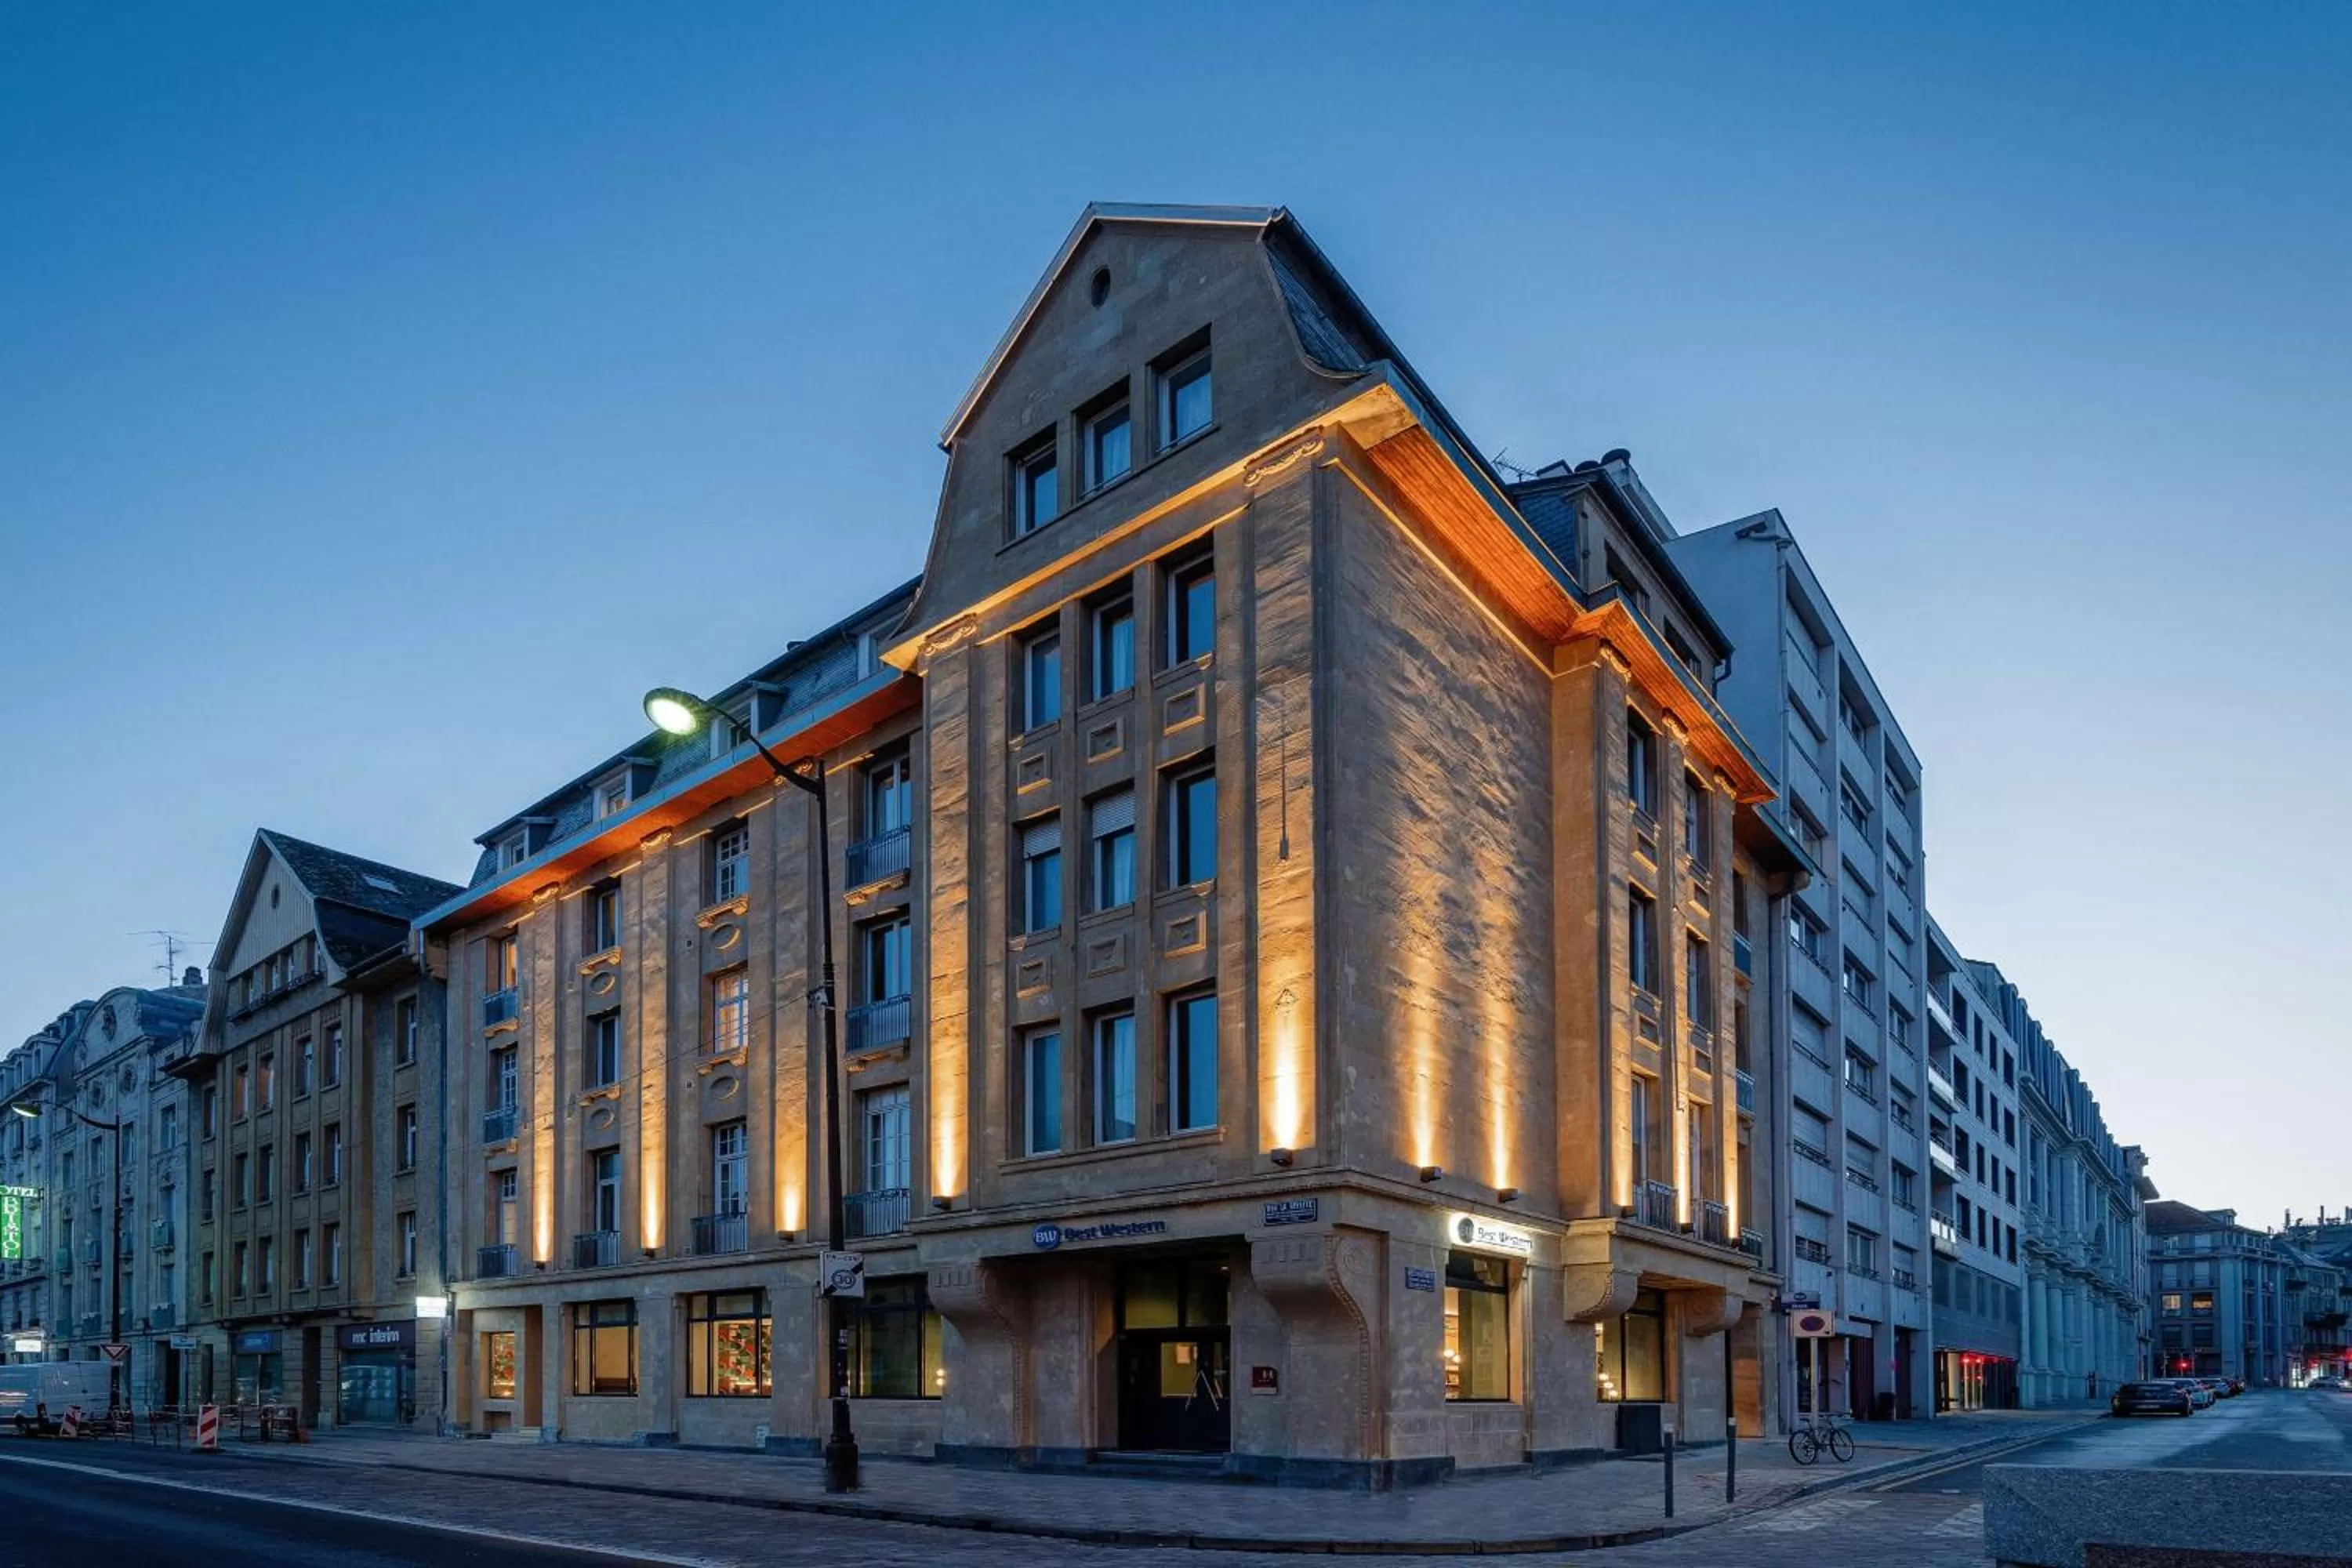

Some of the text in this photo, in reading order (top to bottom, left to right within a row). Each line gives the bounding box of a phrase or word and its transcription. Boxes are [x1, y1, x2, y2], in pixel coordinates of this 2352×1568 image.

[0, 1185, 38, 1197] OTEL
[1035, 1221, 1167, 1243] BW Best Western
